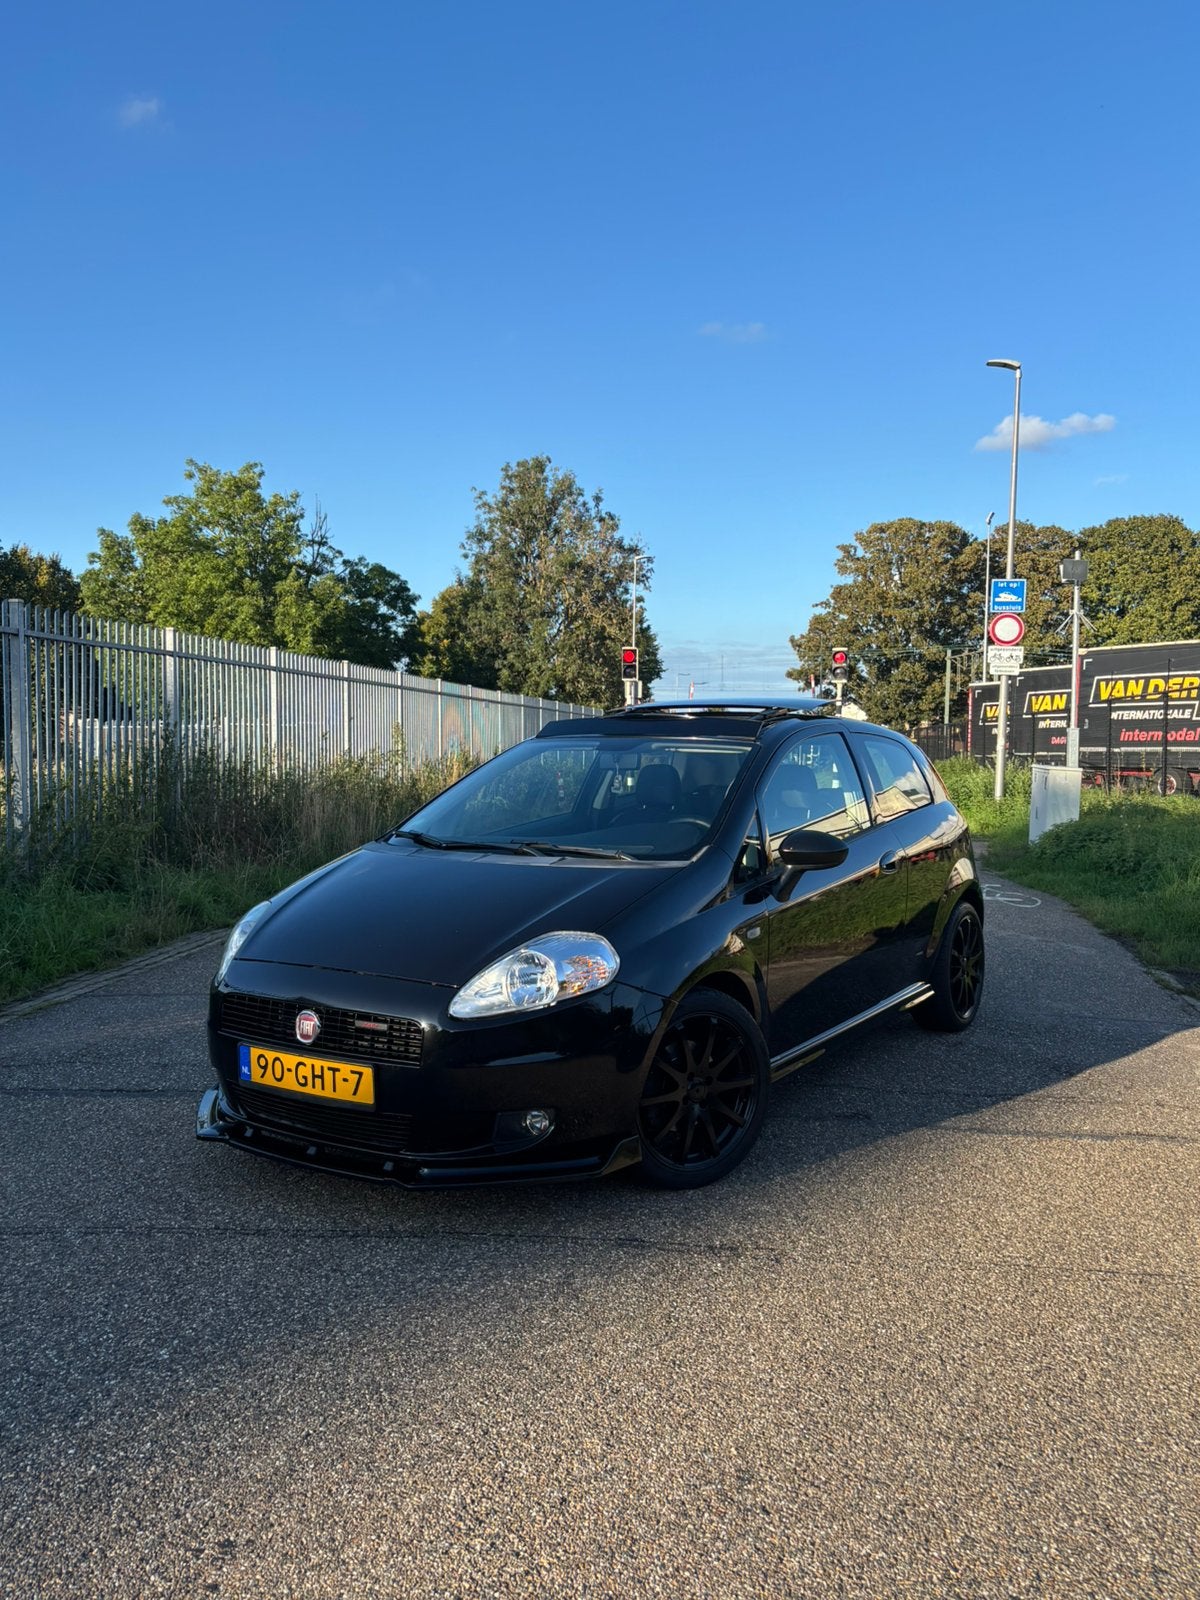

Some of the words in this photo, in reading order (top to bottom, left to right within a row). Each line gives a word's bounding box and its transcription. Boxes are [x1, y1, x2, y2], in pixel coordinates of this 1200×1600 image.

[1099, 678, 1145, 702] VAN
[1147, 676, 1200, 700] DER
[1031, 694, 1068, 713] VAN
[1111, 708, 1193, 720] NTERNATIOALE
[300, 1020, 315, 1036] FIAT
[241, 1066, 251, 1075] NL
[256, 1053, 364, 1097] 90-GHT-7
